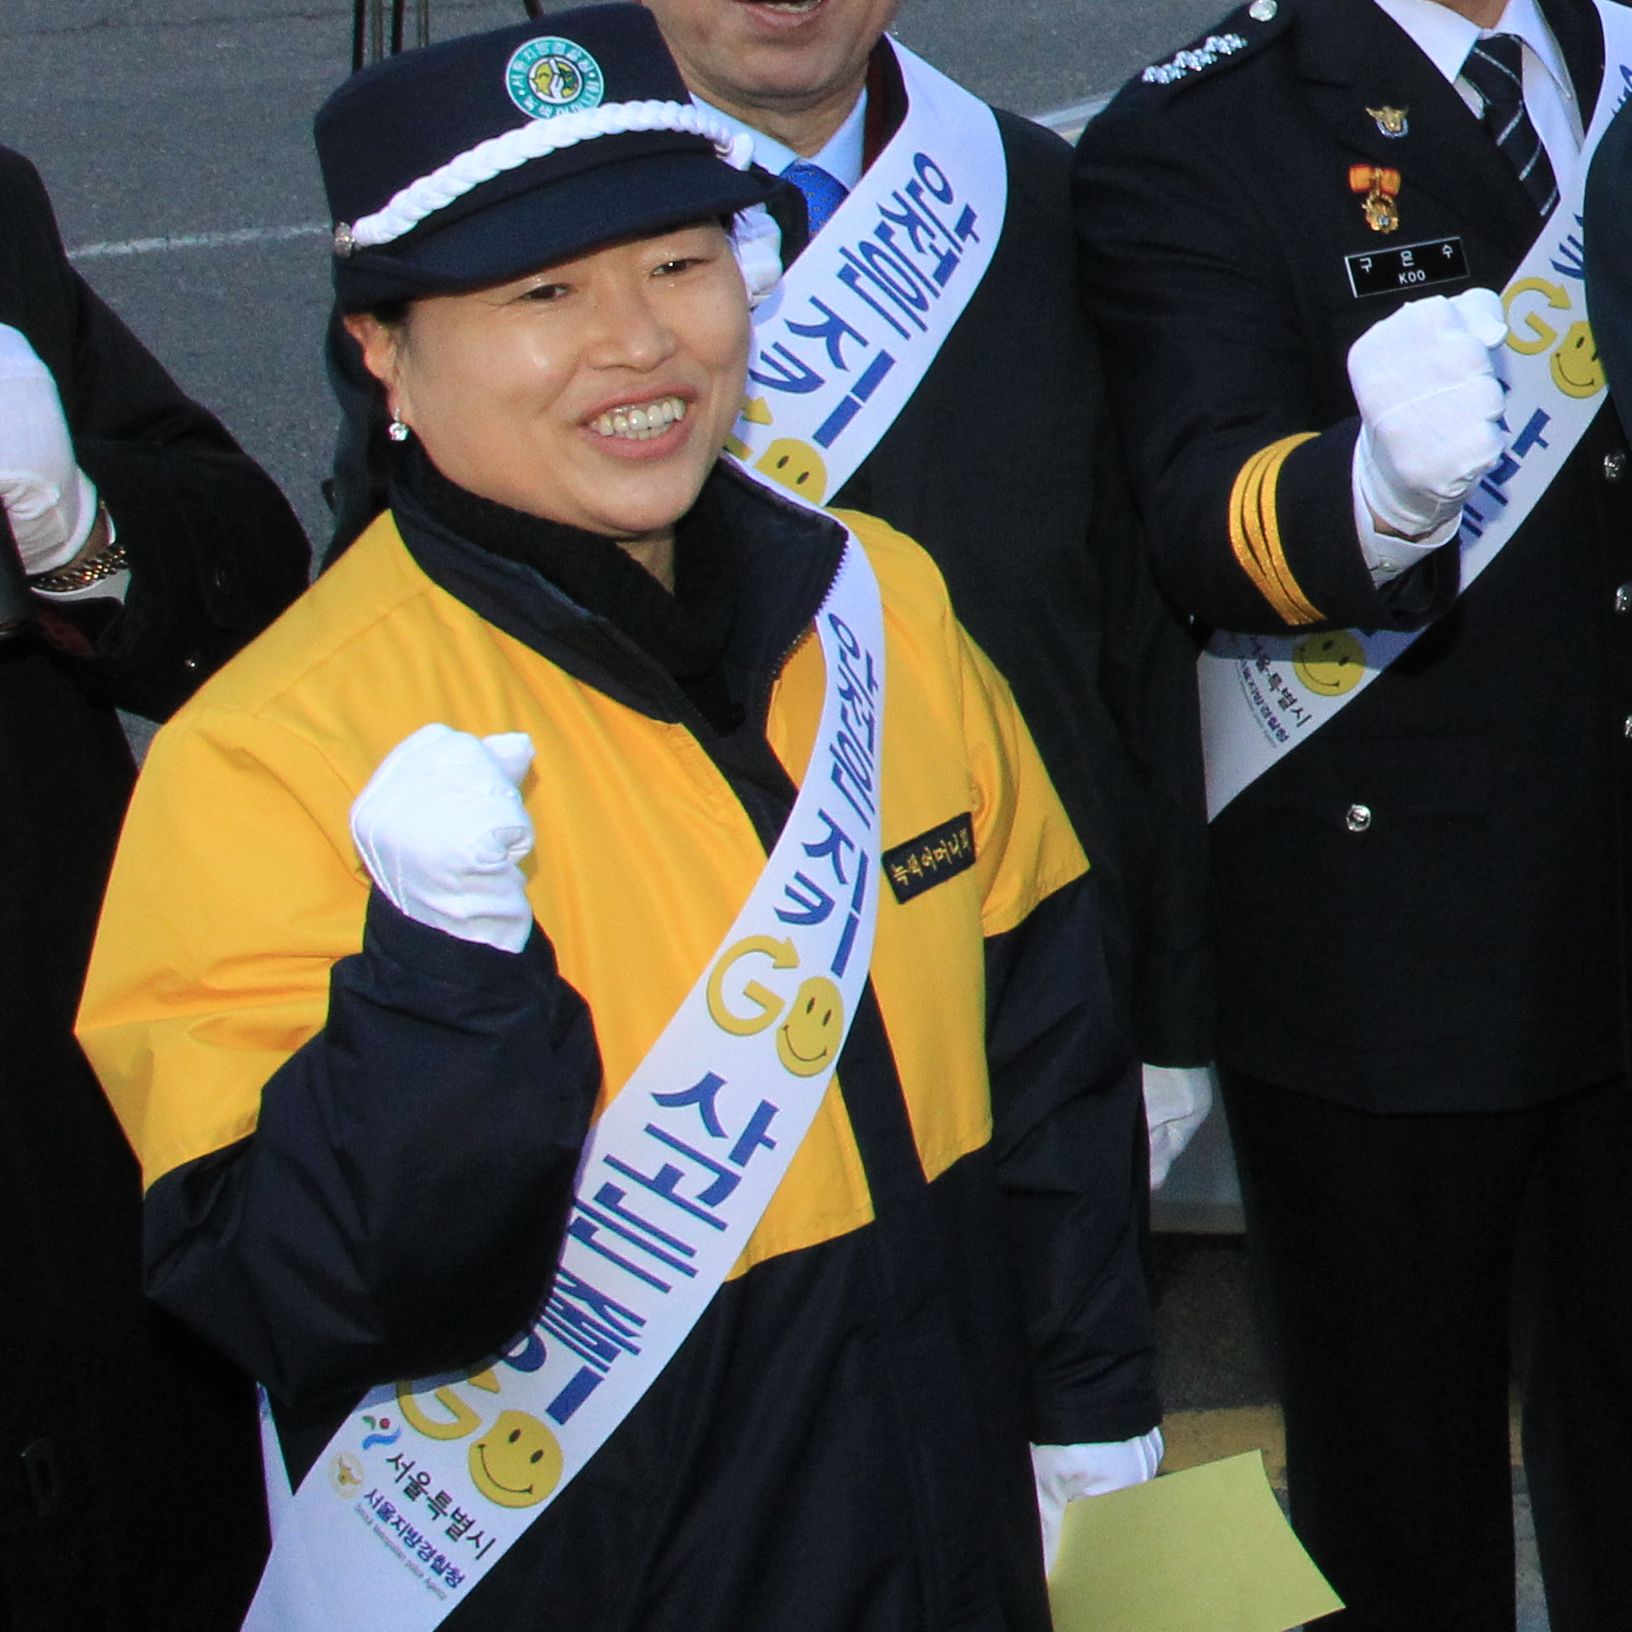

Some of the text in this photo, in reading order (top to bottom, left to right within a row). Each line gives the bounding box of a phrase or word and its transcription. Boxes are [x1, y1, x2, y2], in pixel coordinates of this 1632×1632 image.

[836, 150, 982, 342] 안전은
[1398, 269, 1427, 285] KOO
[826, 610, 879, 828] 안전은
[568, 1070, 780, 1293] 사고는
[363, 1488, 467, 1590] 서울지방경찰청
[386, 1452, 498, 1560] 서울특별시
